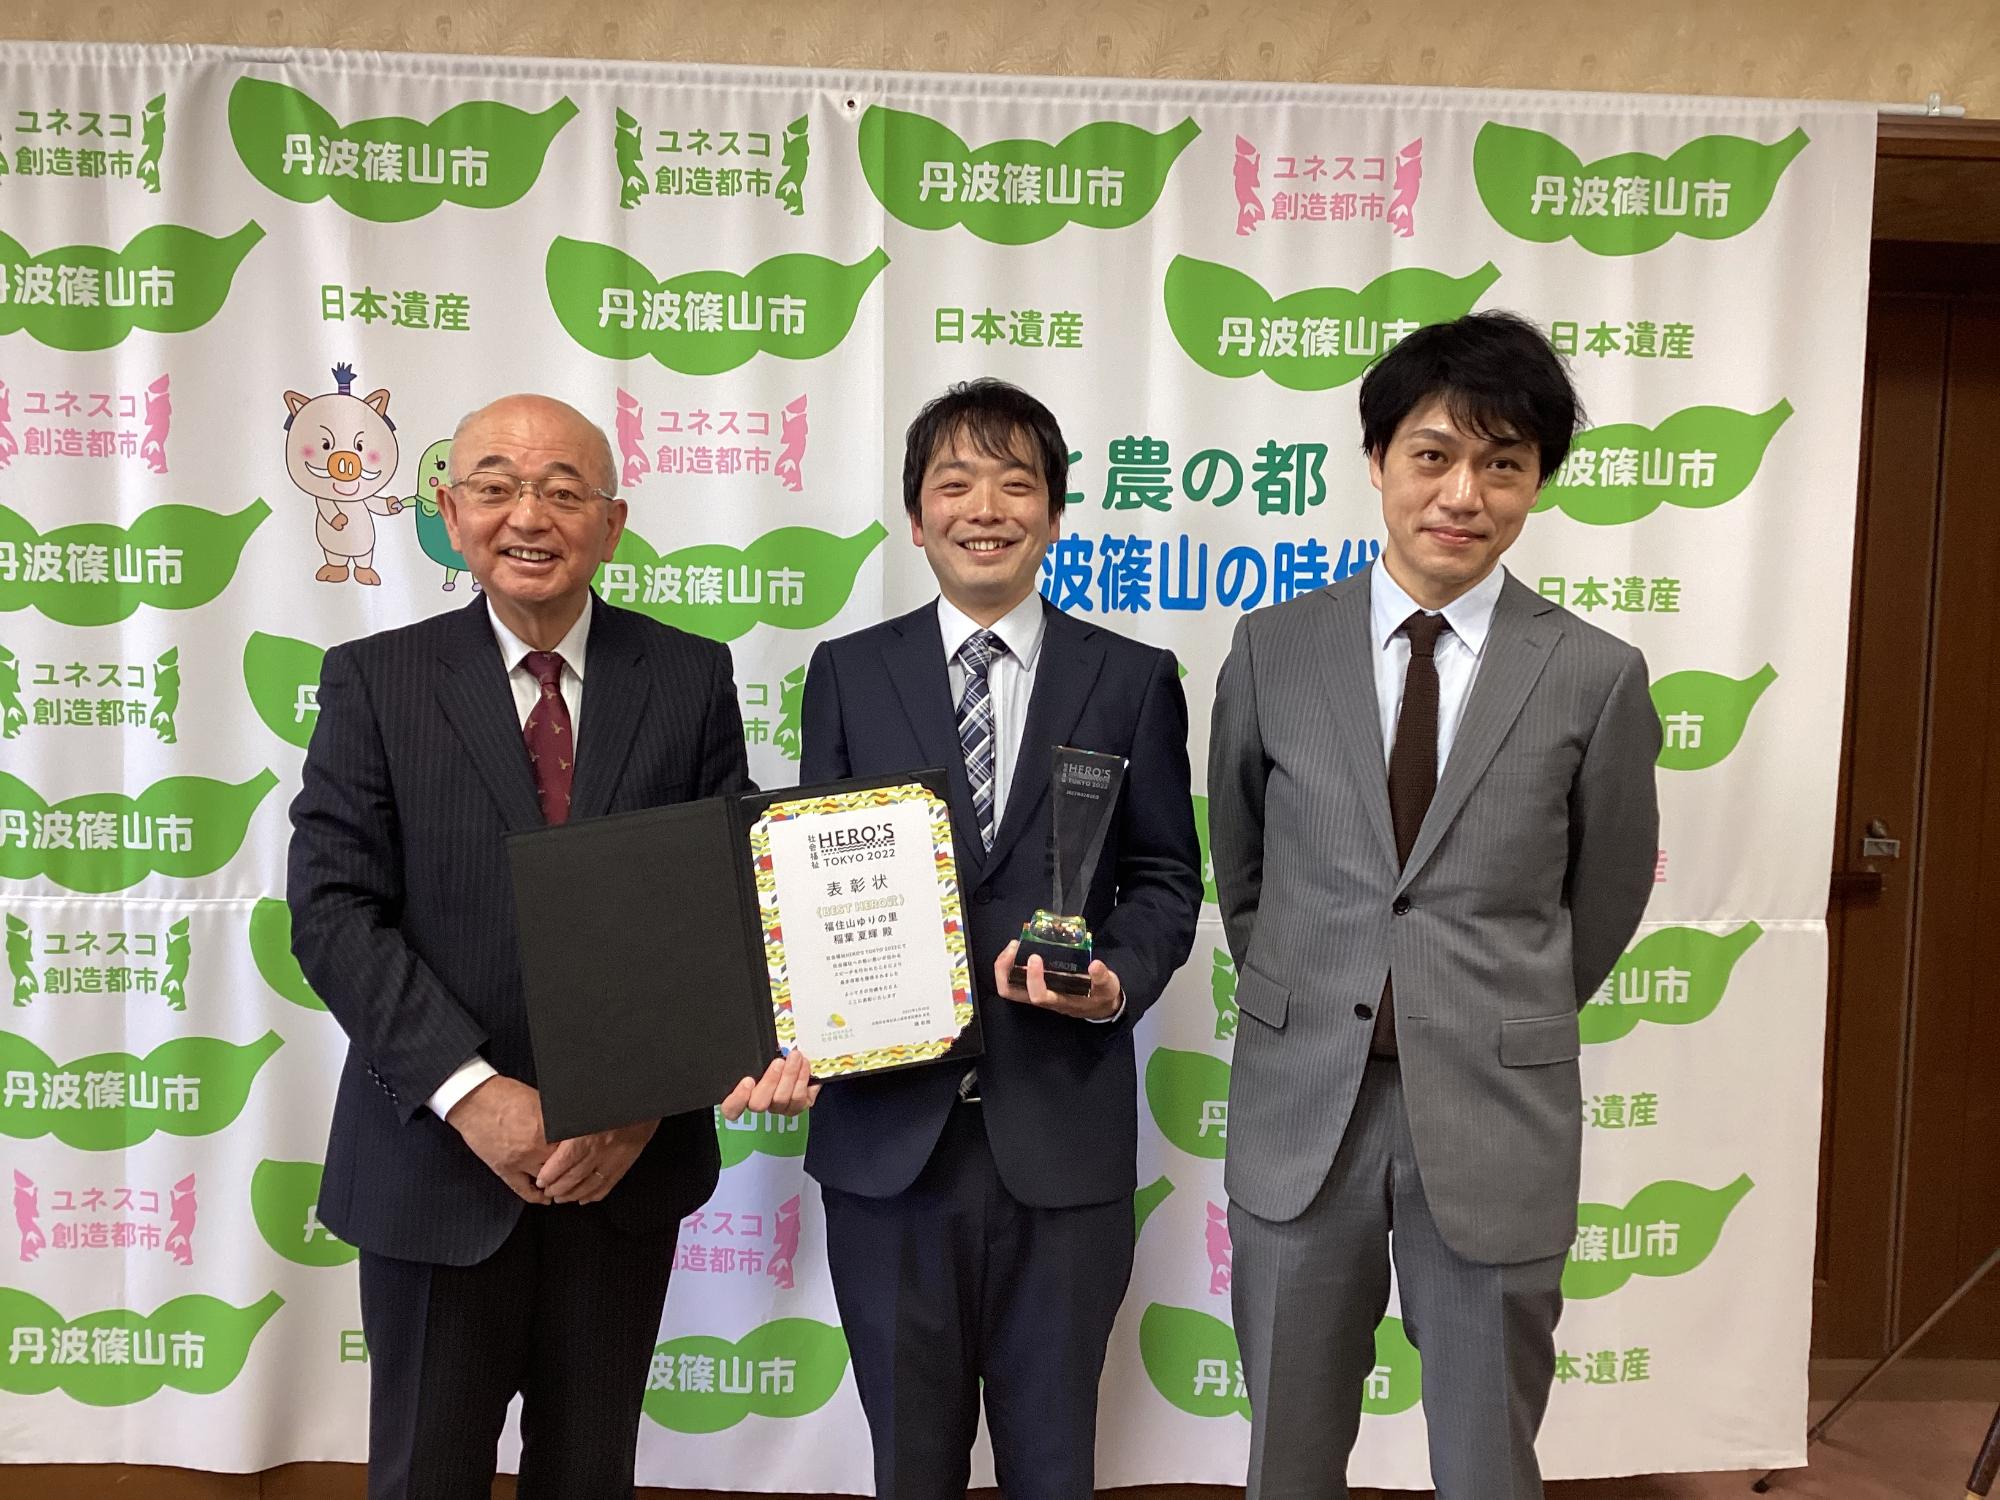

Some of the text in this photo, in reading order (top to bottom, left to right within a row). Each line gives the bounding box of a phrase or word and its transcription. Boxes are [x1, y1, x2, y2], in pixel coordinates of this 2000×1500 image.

[15, 110, 133, 137] ユネスコ
[655, 129, 771, 157] ユネスコ
[15, 146, 133, 179] 創造都市
[282, 133, 488, 188] 丹波篠山市
[1274, 155, 1384, 182] ユネスコ
[655, 165, 773, 198] 創造都市
[918, 161, 1125, 206] 丹波篠山市
[1531, 175, 1731, 219] 丹波篠山市
[1272, 191, 1384, 223] 創造都市
[321, 284, 470, 331] 日本遺産
[599, 287, 806, 335] 丹波篠山市
[934, 307, 1084, 348] 日本遺産
[1551, 321, 1695, 359] 日本遺産
[23, 391, 135, 418] ユネスコ
[657, 409, 770, 436] ユネスコ
[23, 428, 137, 459] 創造都市
[656, 446, 771, 475] 創造都市
[600, 563, 805, 607] 丹波篠山市
[1539, 576, 1681, 613] 日本遺産
[33, 662, 145, 689] ユネスコ
[33, 697, 147, 727] 創造都市
[0, 809, 194, 853] 丹波篠山市
[823, 848, 895, 867] TOKYO 2022
[827, 873, 888, 897] 表彰状
[43, 931, 156, 957] ユネスコ
[43, 966, 158, 994] 創造都市
[4, 1071, 200, 1113] 丹波篠山市
[52, 1188, 159, 1213] ユネスコ
[51, 1222, 162, 1251] 創造都市
[9, 1327, 205, 1370] 丹波篠山市
